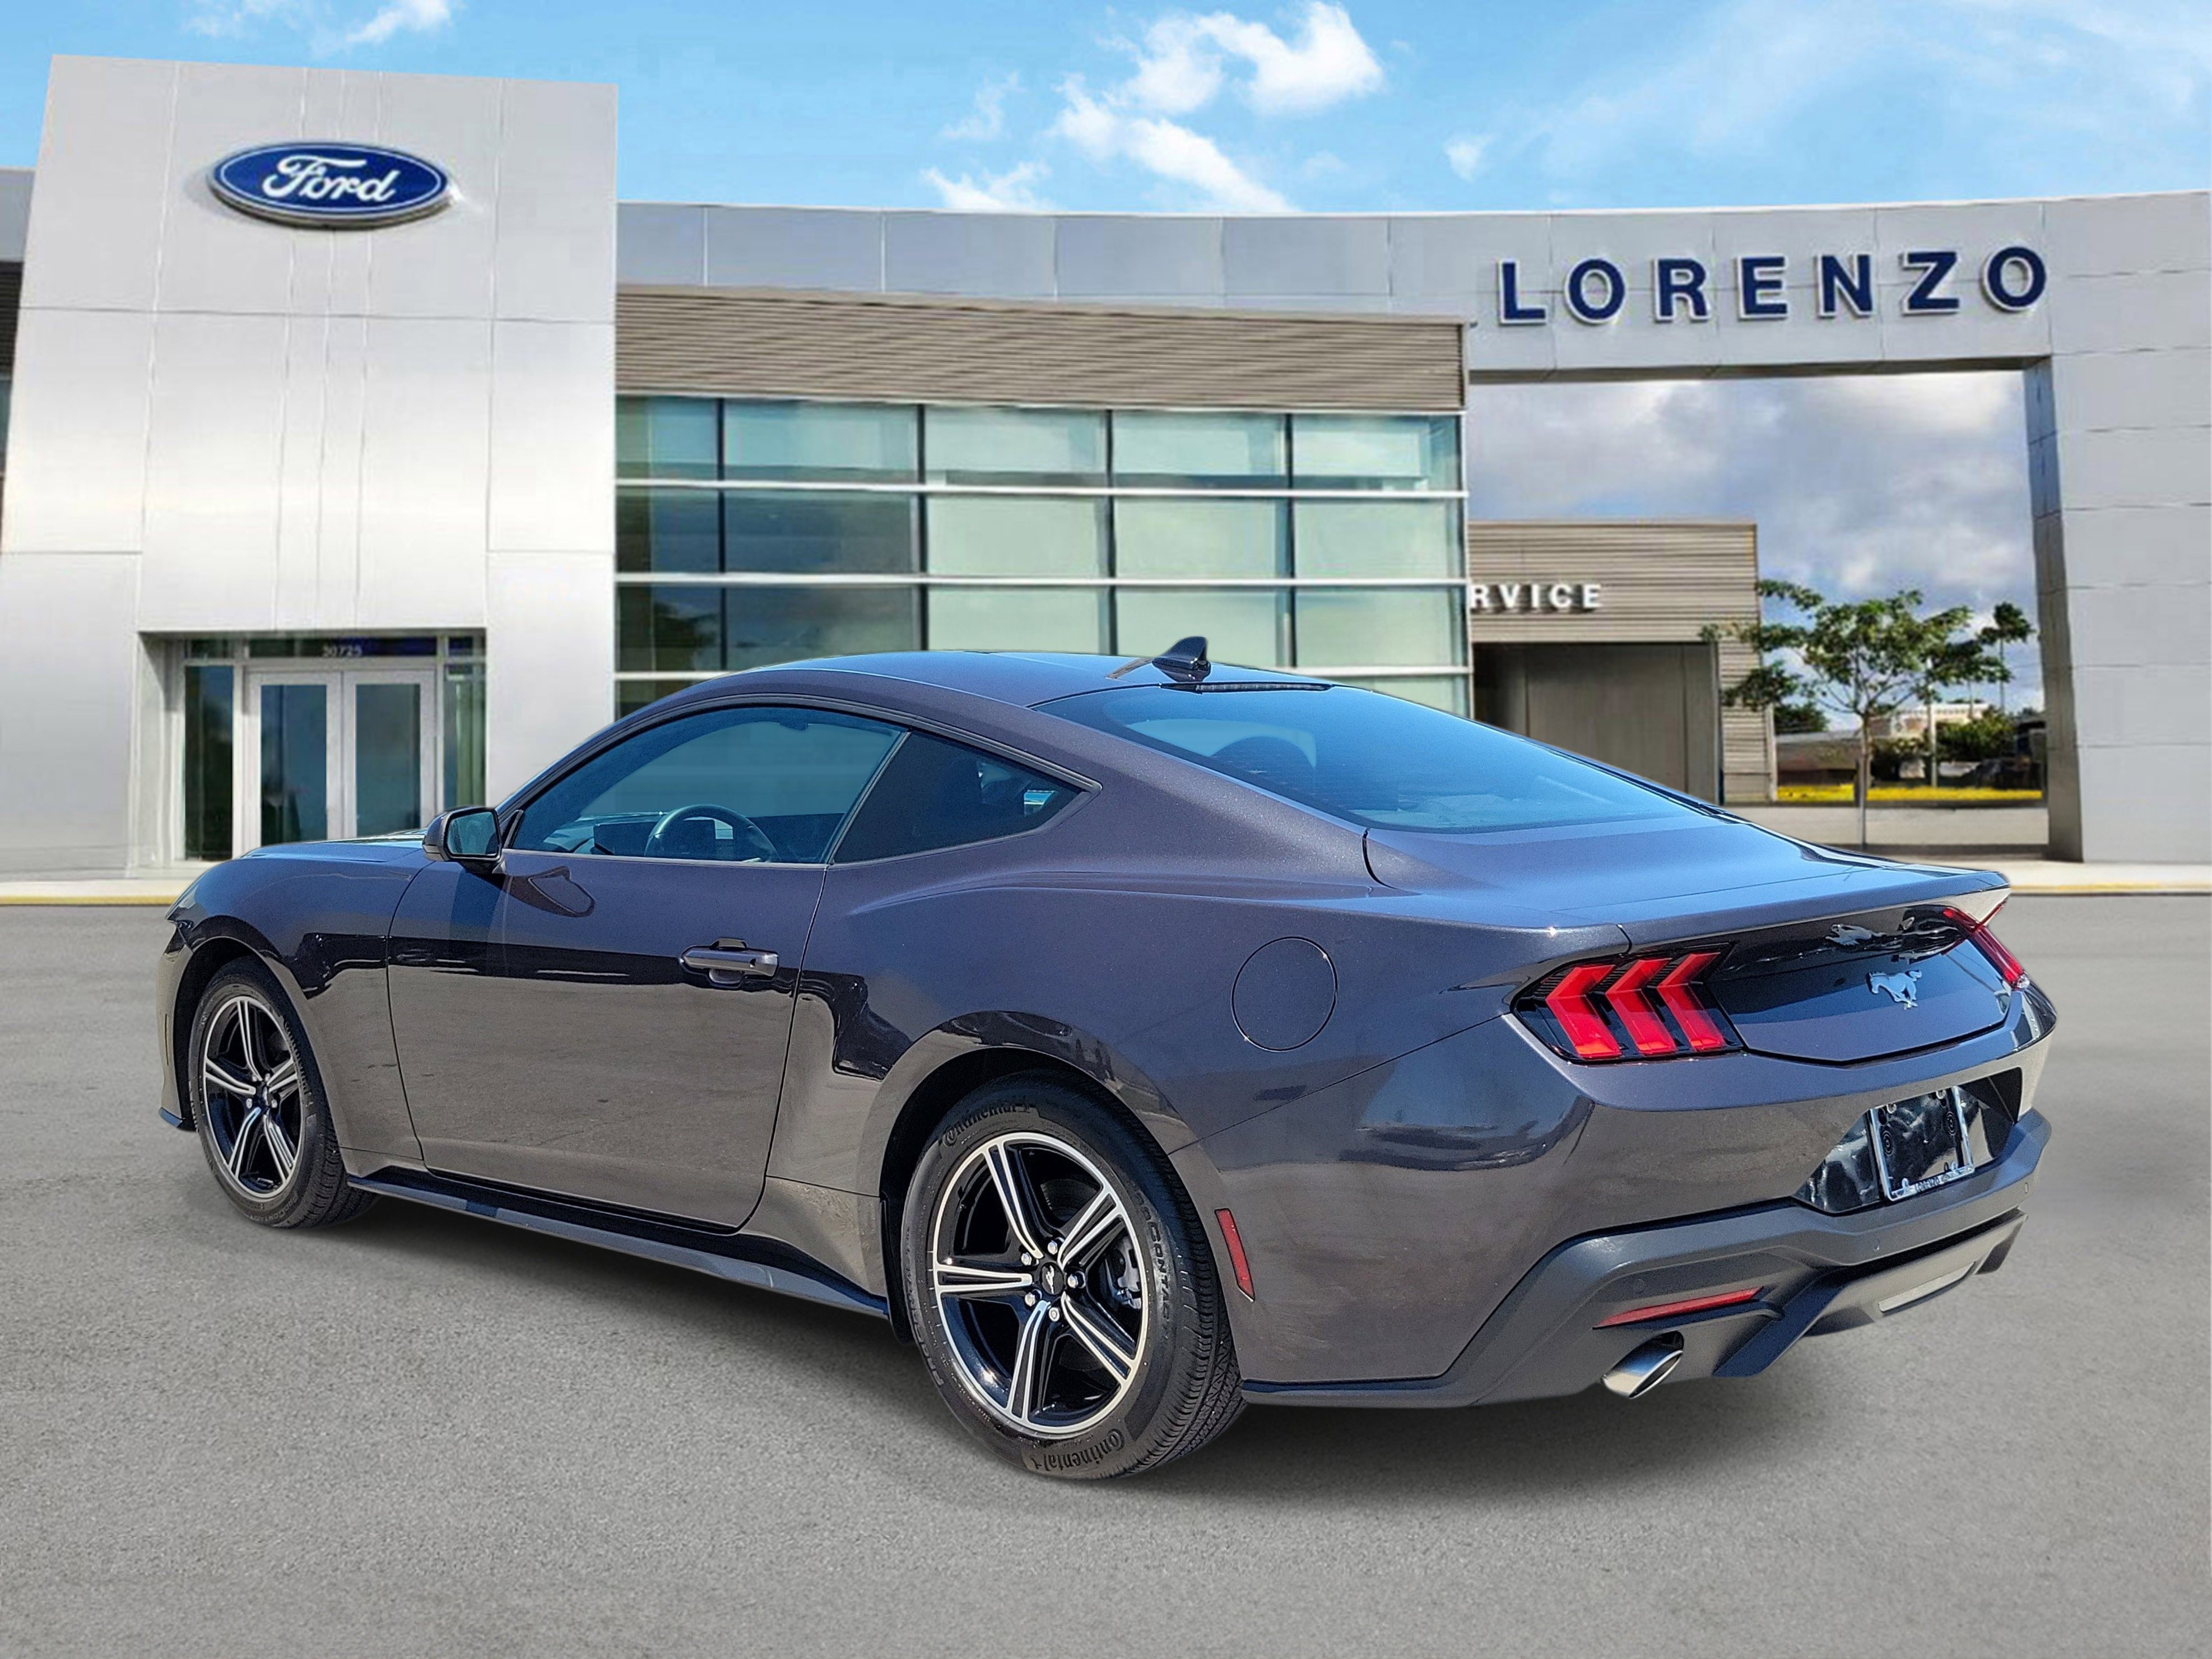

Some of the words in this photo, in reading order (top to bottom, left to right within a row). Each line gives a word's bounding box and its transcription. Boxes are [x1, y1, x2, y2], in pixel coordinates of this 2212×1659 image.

[262, 154, 401, 202] Ford
[1497, 245, 2047, 325] LORENZO
[1043, 1429, 1125, 1472] Continental
